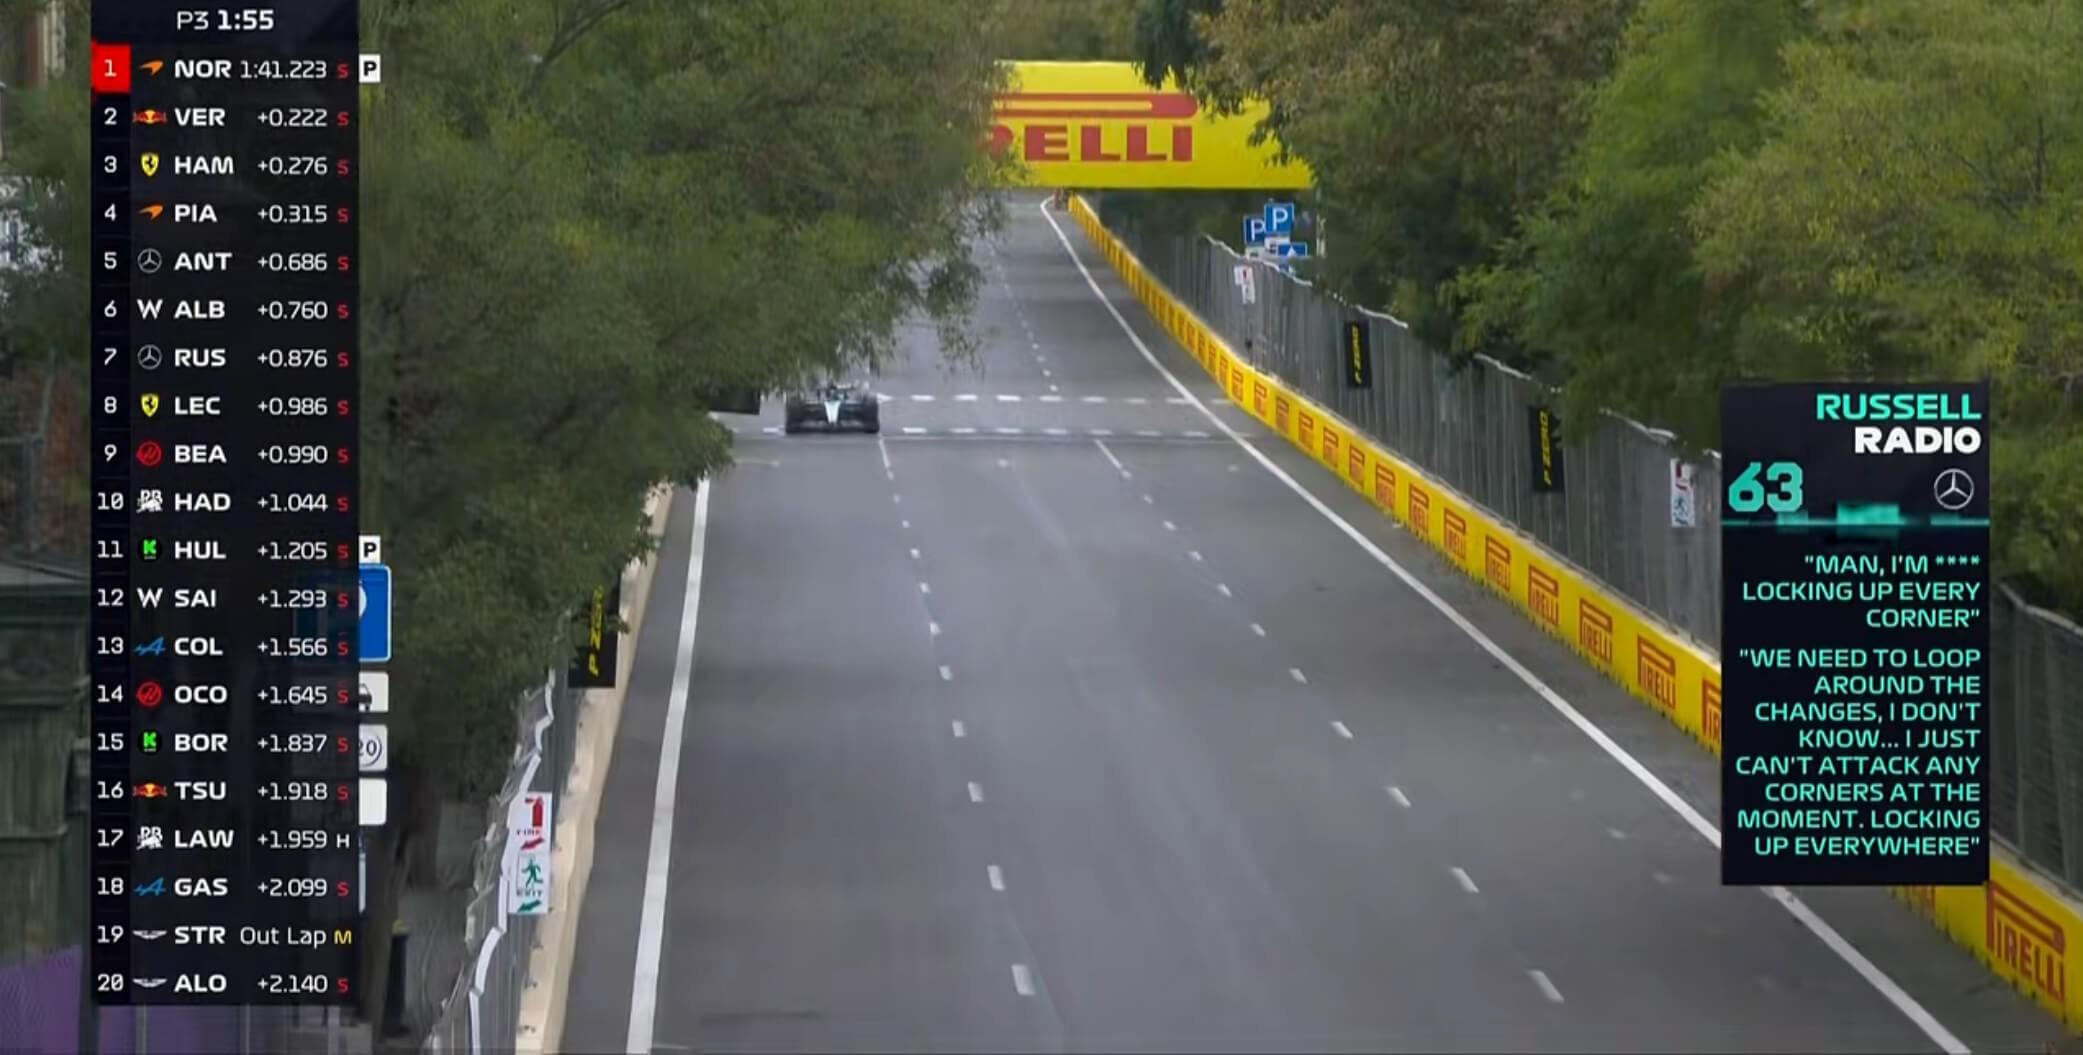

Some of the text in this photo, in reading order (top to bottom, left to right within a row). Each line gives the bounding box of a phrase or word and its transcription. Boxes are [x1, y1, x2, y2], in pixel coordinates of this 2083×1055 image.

[1251, 219, 1265, 241] P
[1272, 207, 1288, 231] P
[1580, 598, 1612, 664] PIRELLI
[1638, 634, 1676, 710] PIRELLI
[1987, 880, 2066, 1002] PIRELLI
